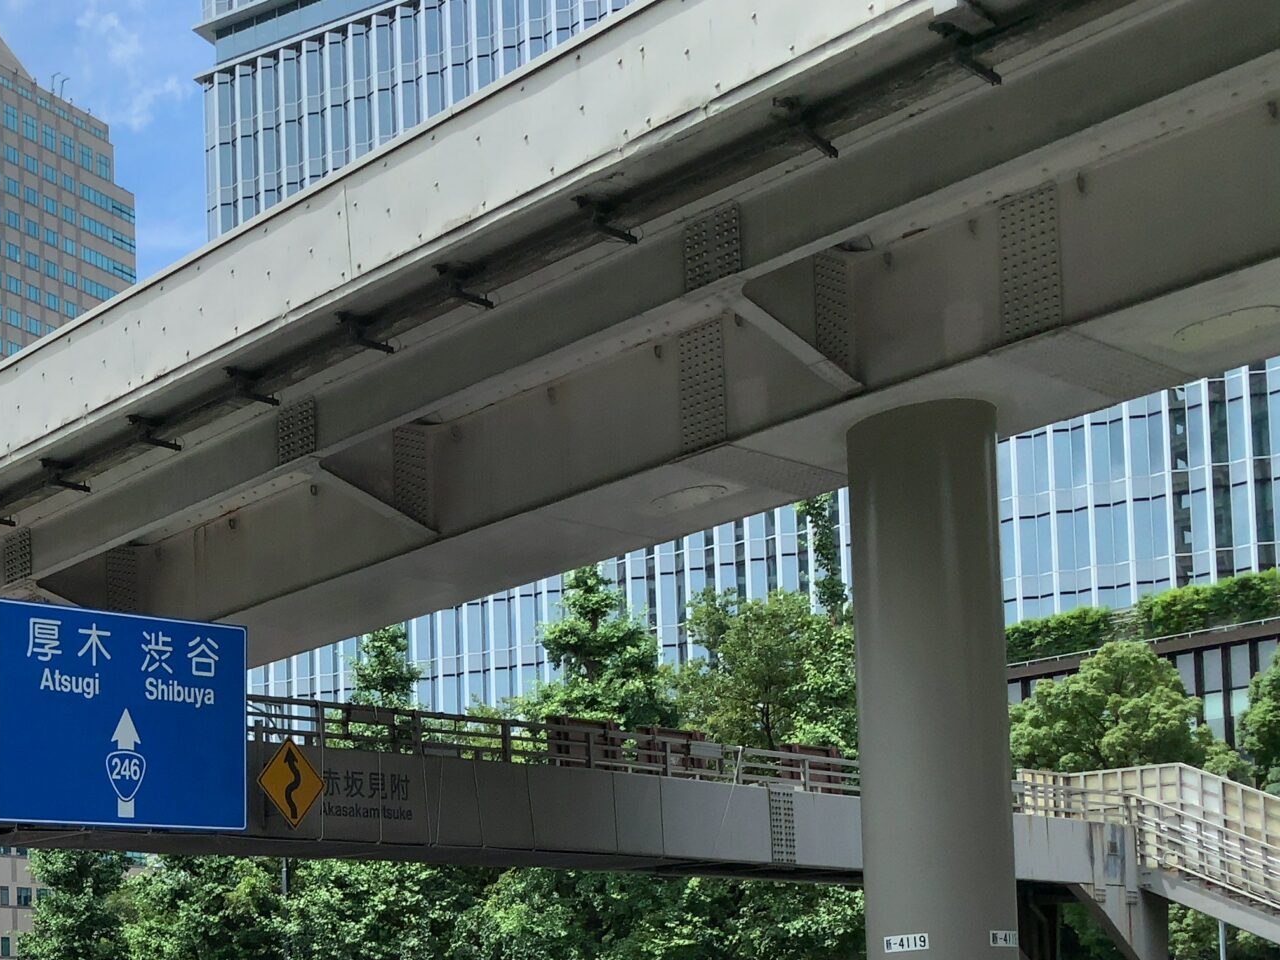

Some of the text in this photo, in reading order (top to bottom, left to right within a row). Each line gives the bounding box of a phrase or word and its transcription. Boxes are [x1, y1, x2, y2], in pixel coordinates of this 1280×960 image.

[26, 617, 112, 667] 厚木
[140, 631, 219, 677] 渋谷
[40, 668, 100, 699] Atsugi
[145, 678, 215, 708] Shibuya
[111, 758, 141, 781] 246
[322, 767, 410, 800] 赤坂見附
[320, 800, 413, 821] Akasakamtsuke
